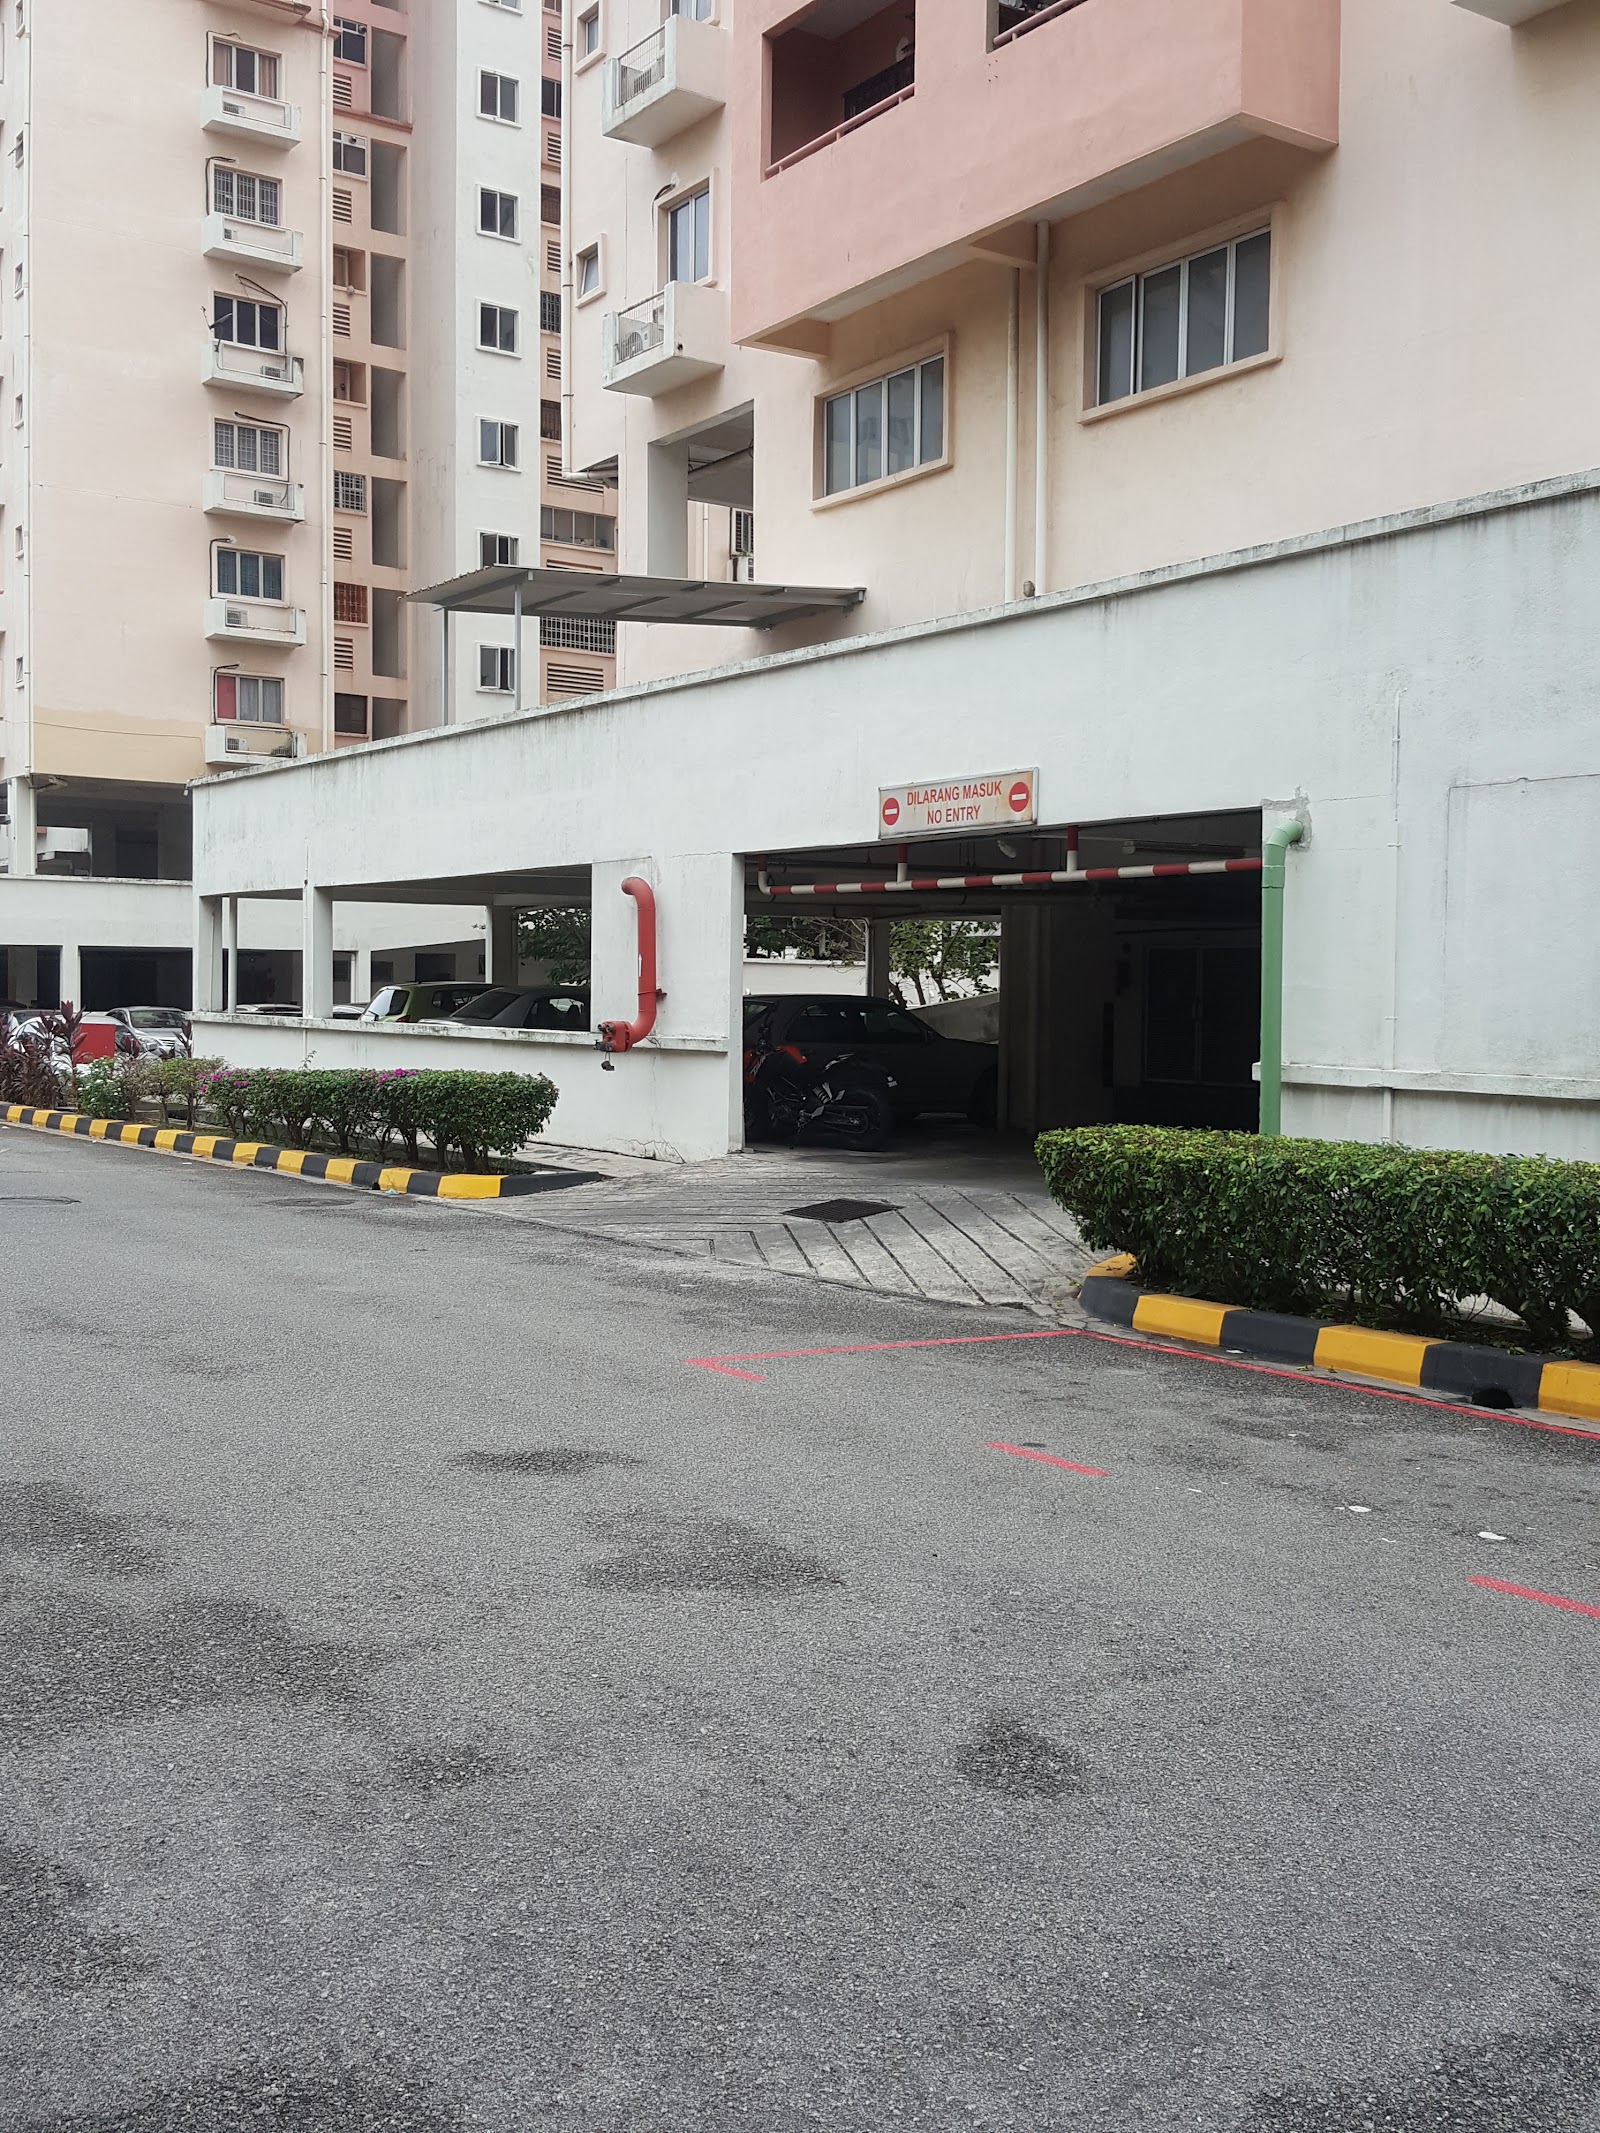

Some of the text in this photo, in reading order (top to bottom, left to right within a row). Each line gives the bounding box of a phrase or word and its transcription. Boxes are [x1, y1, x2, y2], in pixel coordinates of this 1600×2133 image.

[907, 780, 1002, 806] DILARANG MASUK
[927, 805, 981, 825] NO ENTRY
